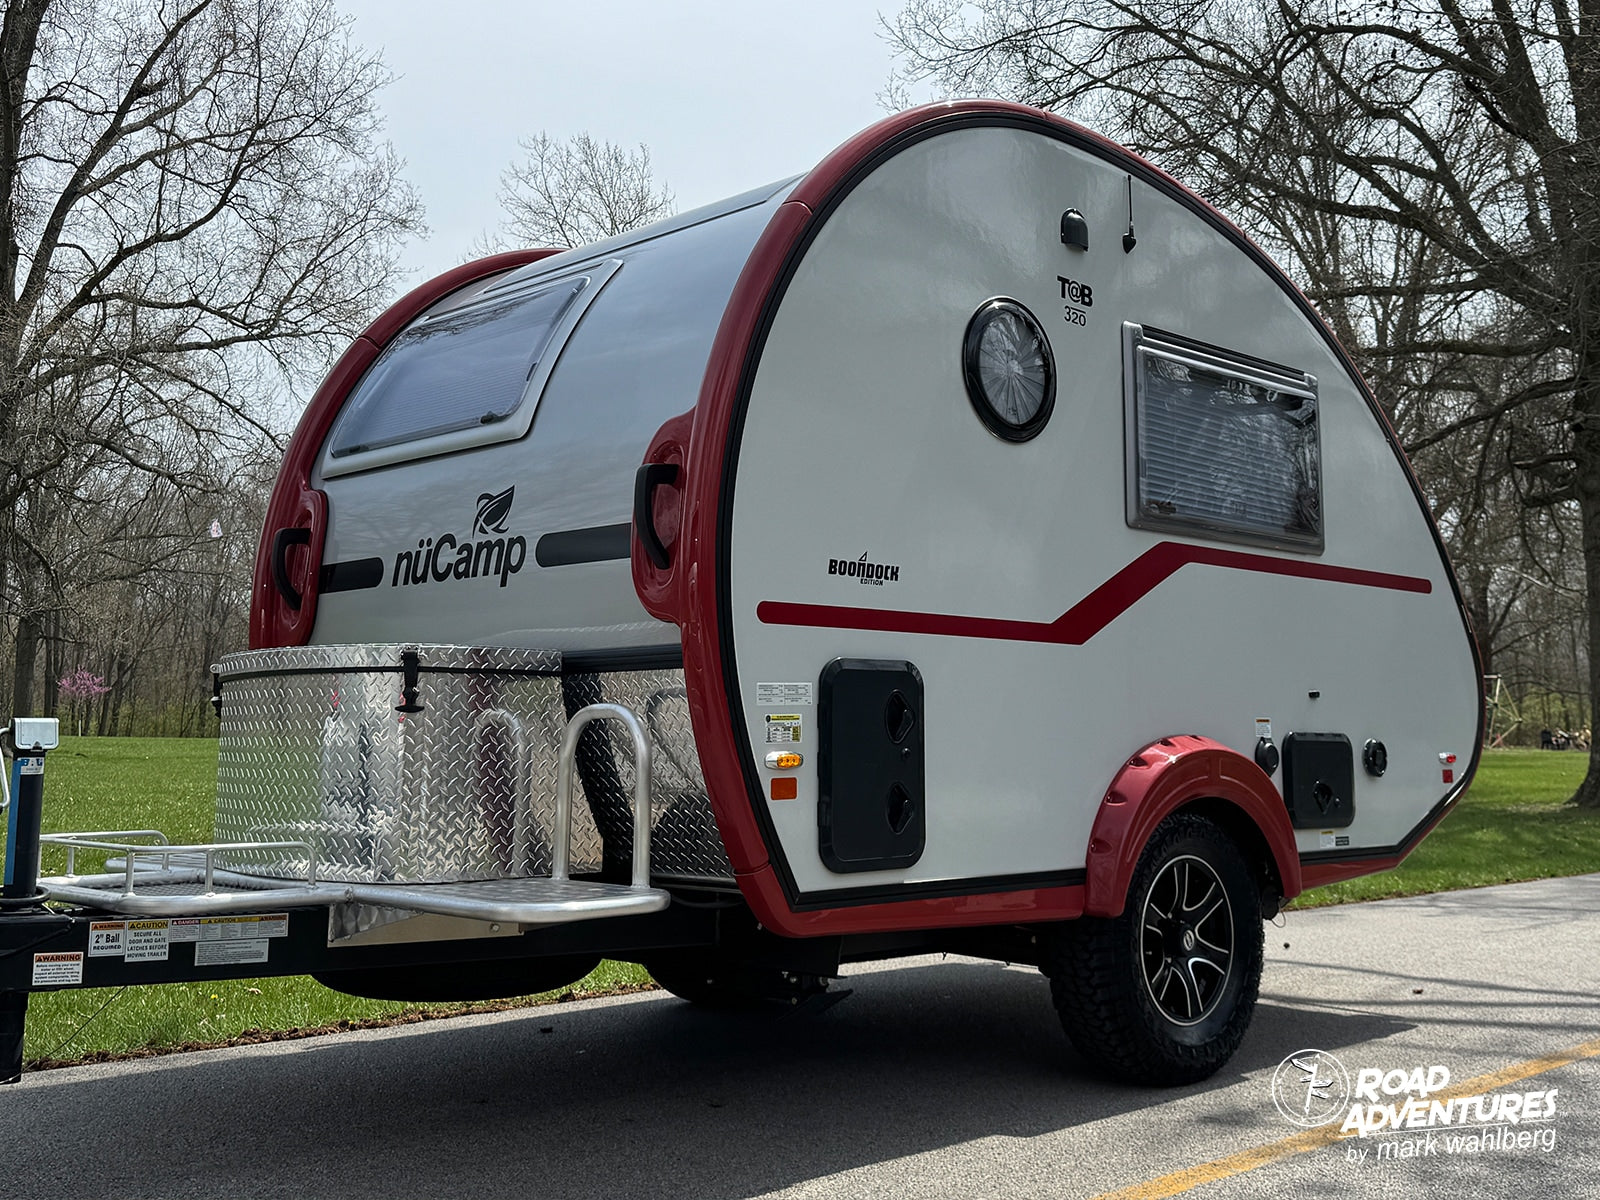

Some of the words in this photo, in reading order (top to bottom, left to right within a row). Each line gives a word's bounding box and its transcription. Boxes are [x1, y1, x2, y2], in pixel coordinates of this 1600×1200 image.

[1057, 275, 1093, 307] T@B
[1064, 305, 1087, 327] 320
[391, 533, 527, 588] nüCamp
[828, 558, 900, 582] BOONDOCK
[860, 578, 884, 586] EDITION
[135, 920, 168, 929] CAUTION
[105, 932, 121, 944] Ball
[43, 953, 81, 962] WARNING
[126, 951, 147, 959] MOVING
